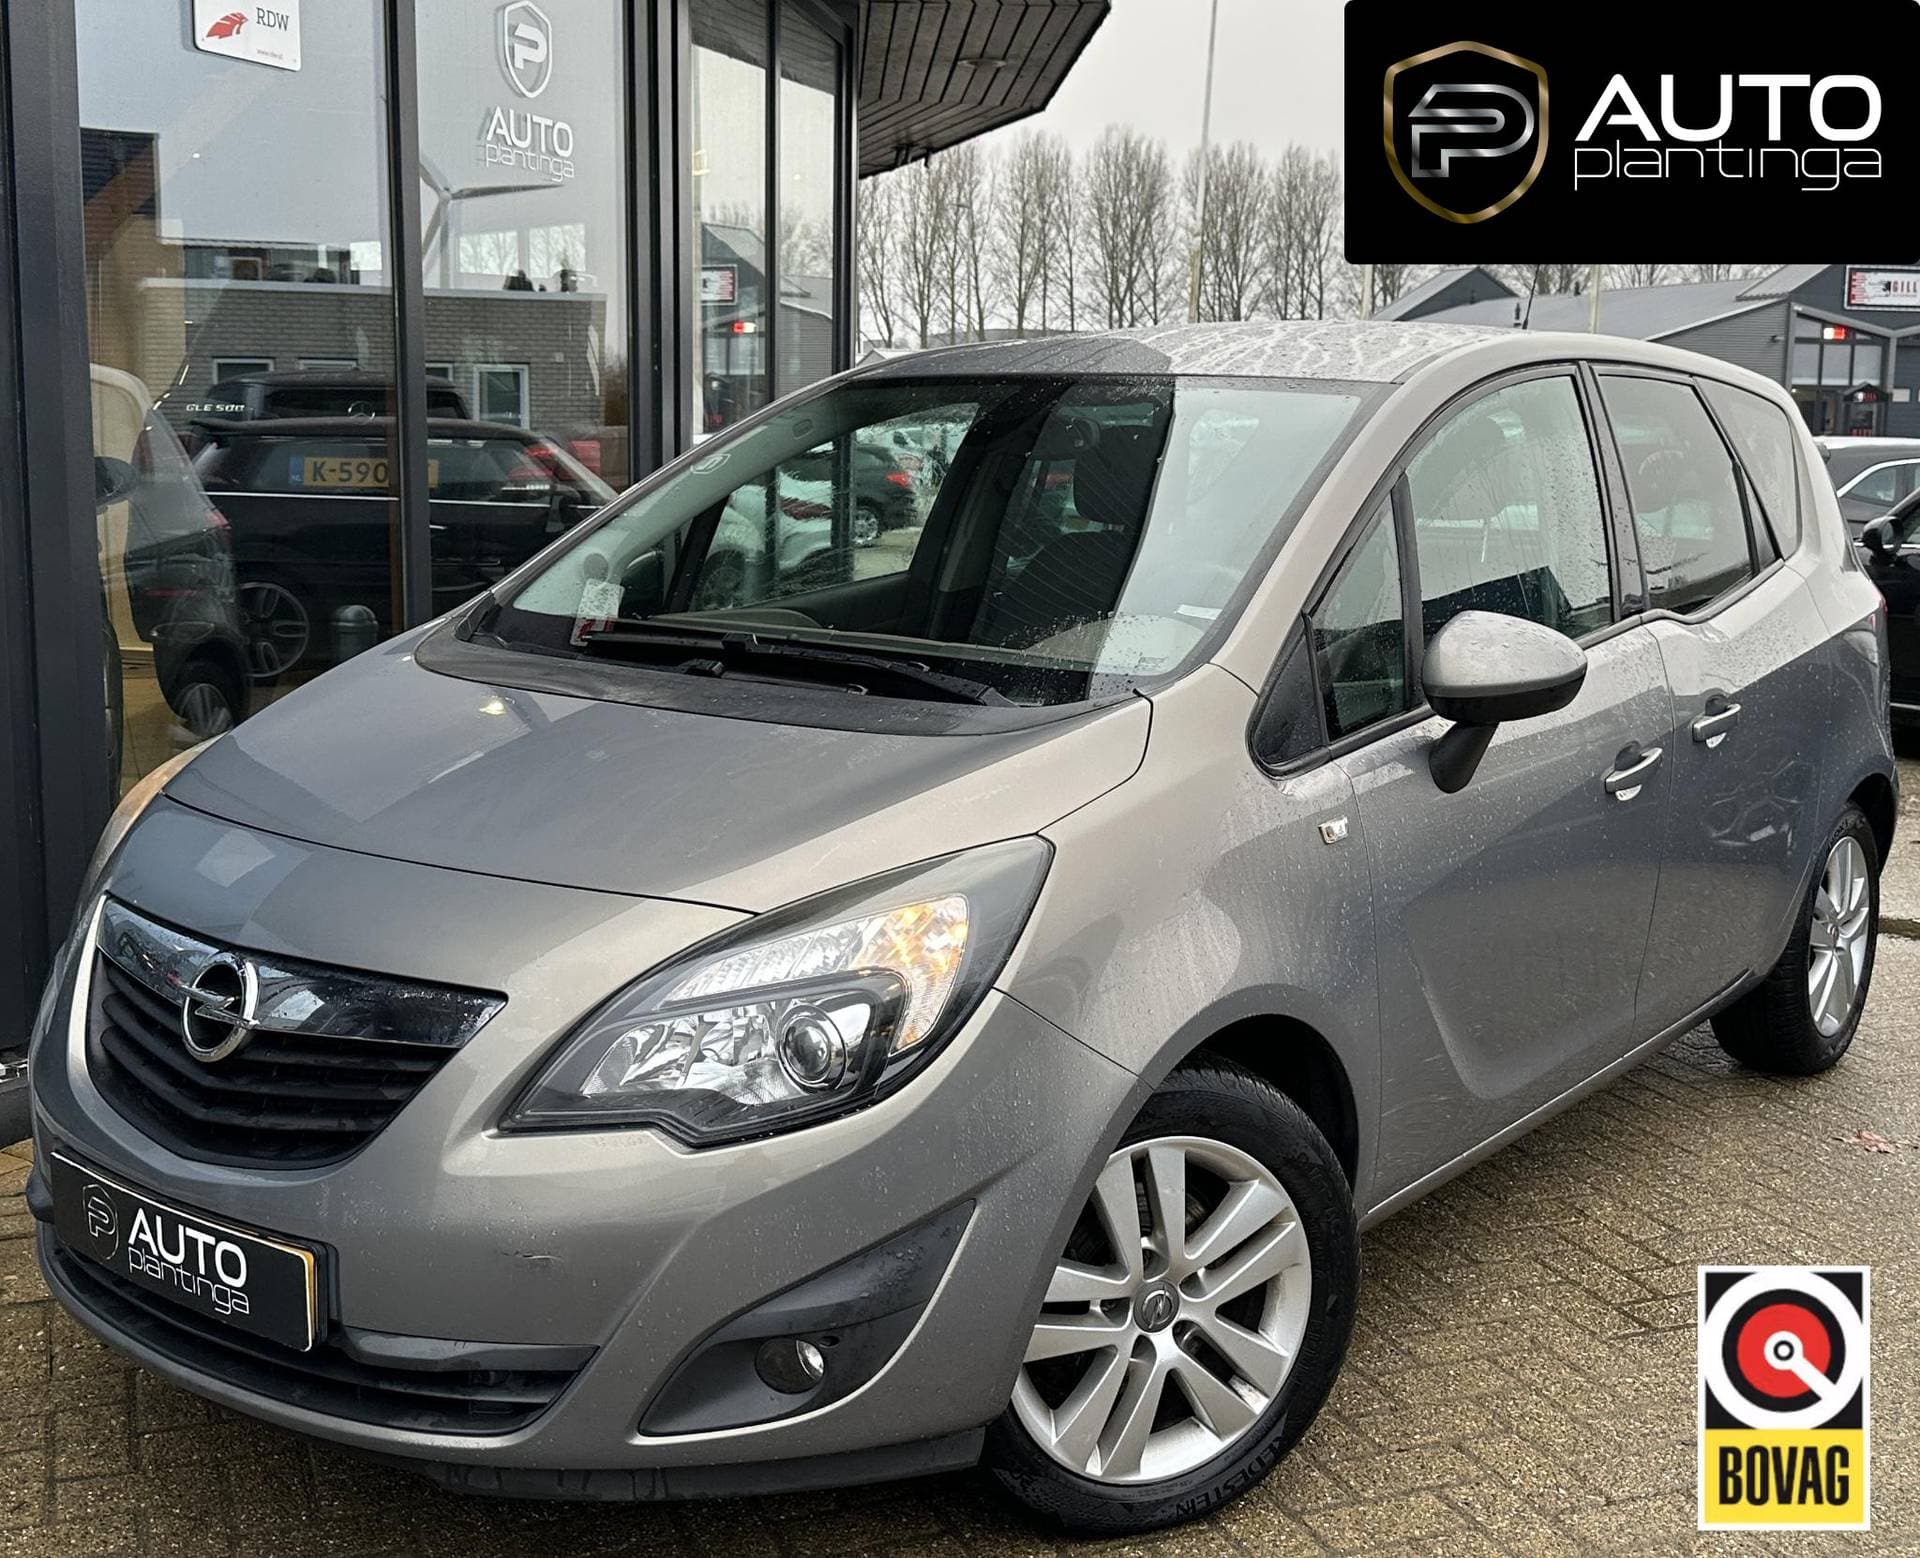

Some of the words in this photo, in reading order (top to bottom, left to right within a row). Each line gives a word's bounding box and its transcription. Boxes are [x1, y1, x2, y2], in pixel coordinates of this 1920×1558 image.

[255, 7, 290, 31] RDW
[486, 105, 574, 158] AUTO
[485, 143, 575, 182] plantinga
[186, 403, 213, 412] GLE
[216, 404, 245, 412] 500
[311, 460, 389, 484] K-590
[128, 1208, 247, 1288] AUTO
[128, 1246, 250, 1315] plantinga
